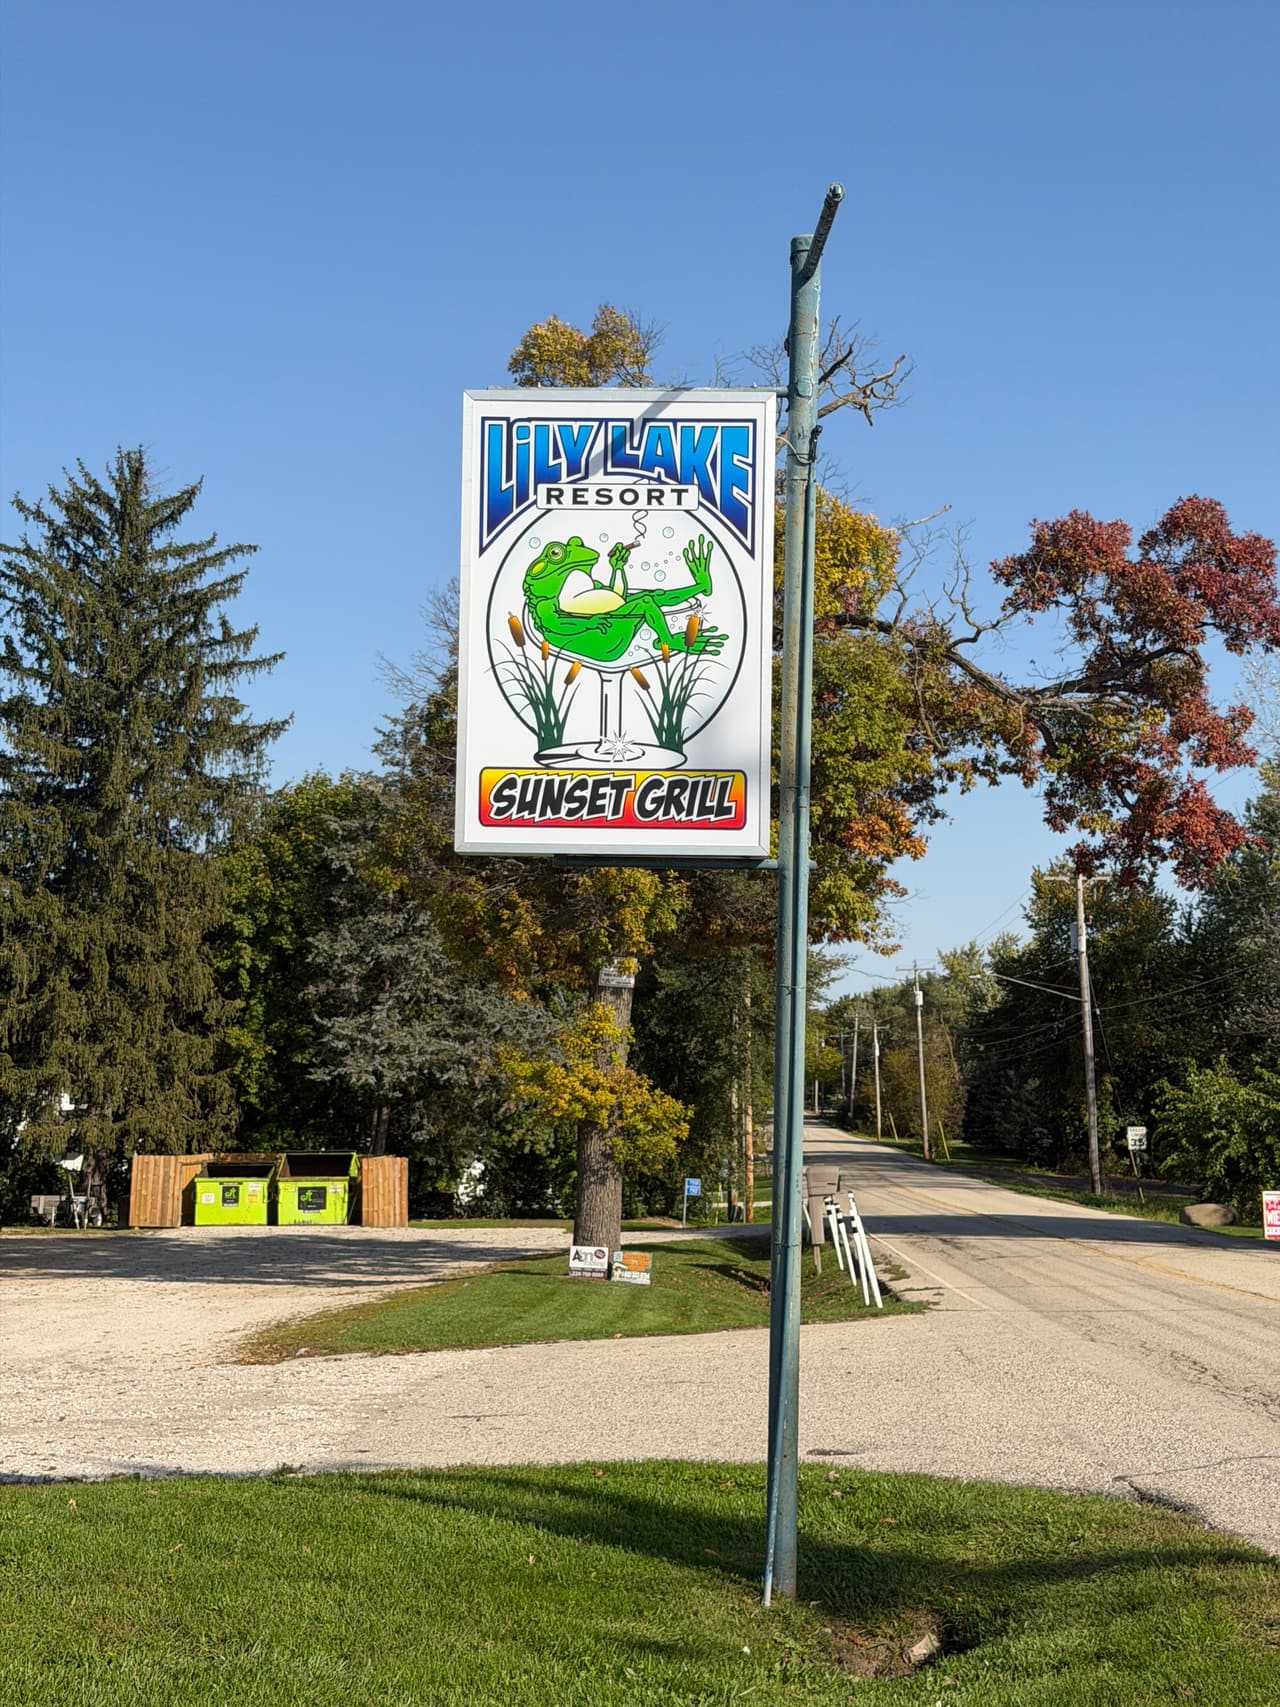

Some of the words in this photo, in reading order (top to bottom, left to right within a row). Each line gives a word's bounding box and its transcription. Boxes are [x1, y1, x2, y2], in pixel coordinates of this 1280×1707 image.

[545, 486, 690, 507] RESORT
[606, 420, 754, 547] LAKE
[490, 774, 635, 821] SUNSET
[634, 775, 737, 822] GRILL
[1130, 1138, 1146, 1147] 35
